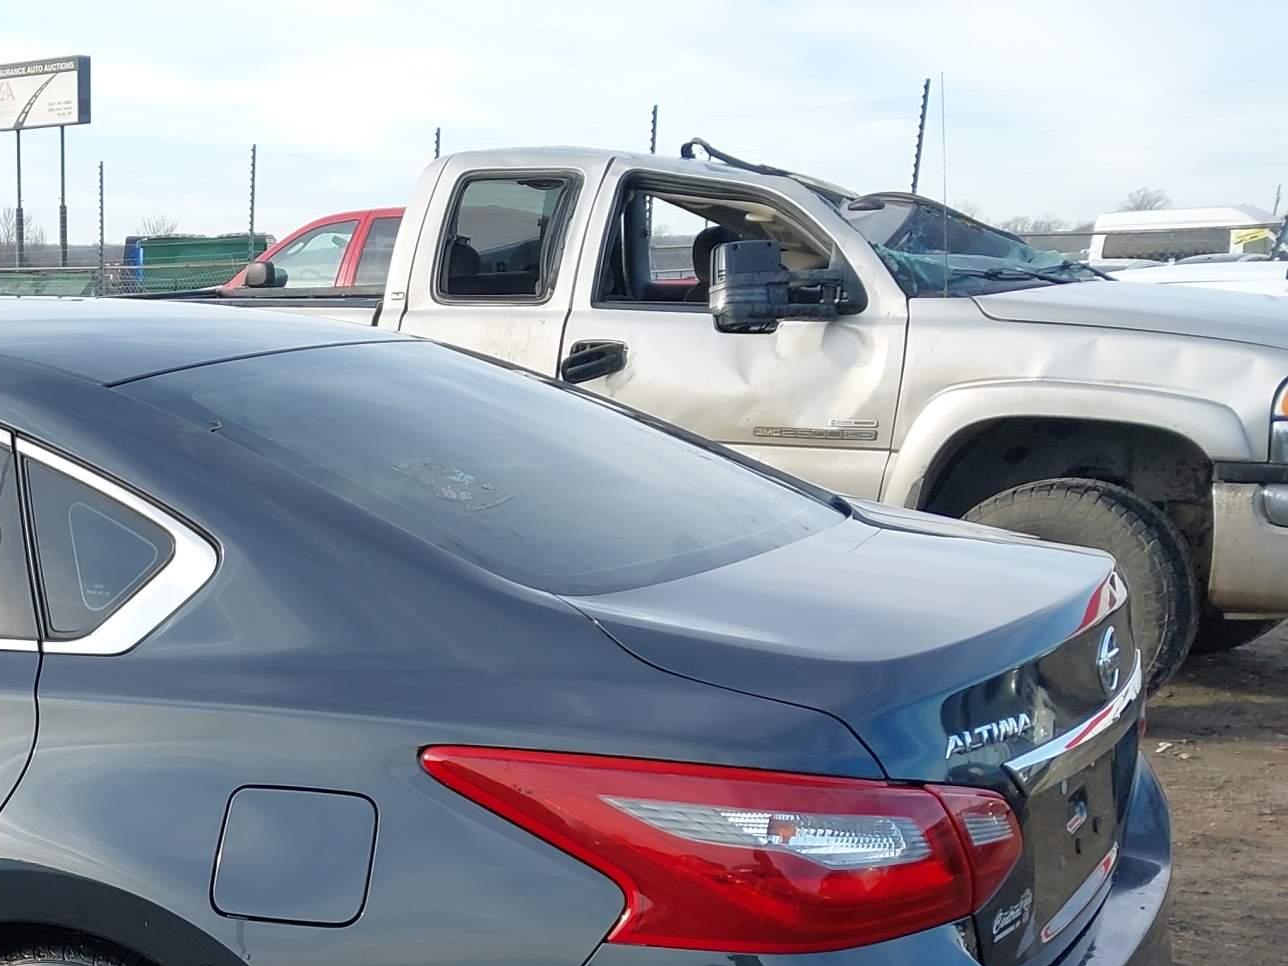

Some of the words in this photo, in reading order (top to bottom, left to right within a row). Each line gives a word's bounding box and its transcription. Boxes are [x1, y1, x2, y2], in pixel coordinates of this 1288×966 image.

[27, 64, 43, 74] AUTO
[44, 61, 75, 71] AUCTIONS
[945, 712, 1032, 760] ALTIMA
